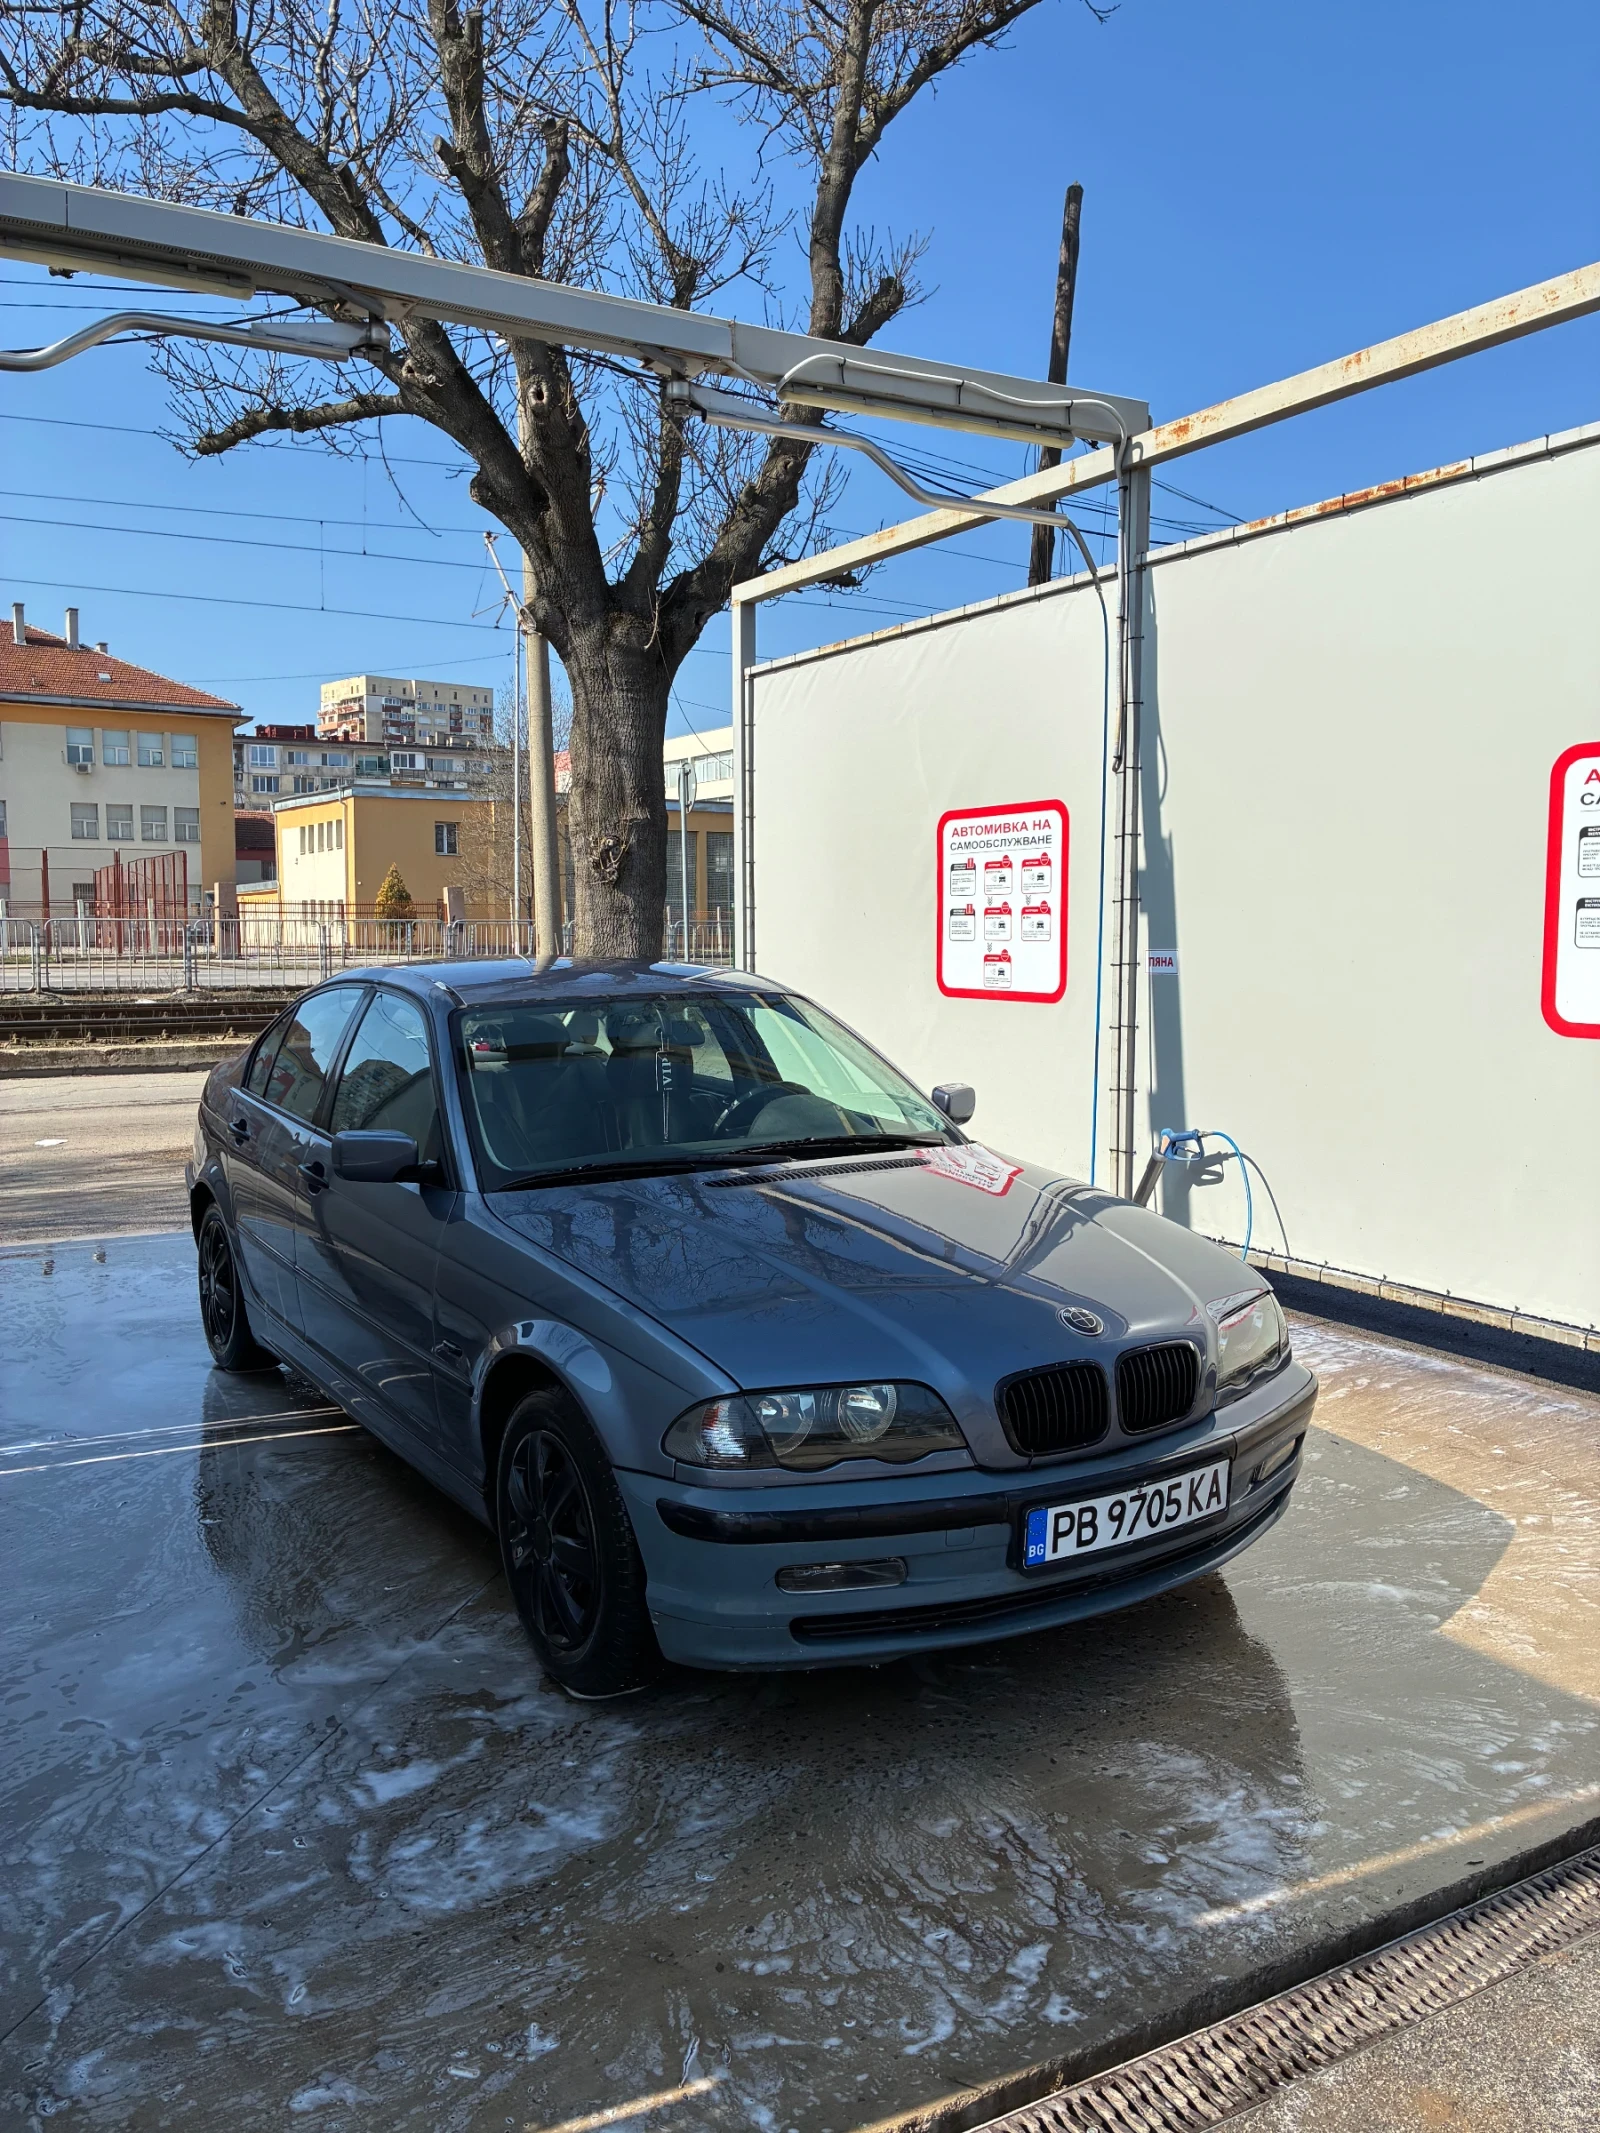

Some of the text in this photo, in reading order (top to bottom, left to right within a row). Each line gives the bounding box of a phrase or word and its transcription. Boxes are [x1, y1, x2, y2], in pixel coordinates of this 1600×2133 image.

[1580, 792, 1600, 806] С
[952, 819, 1052, 838] АВТОМИВКА НА
[950, 834, 1052, 851] САМООБСЛУЖВАНЕ
[1052, 1468, 1222, 1553] PB 9705 KA
[1028, 1544, 1044, 1558] BG
